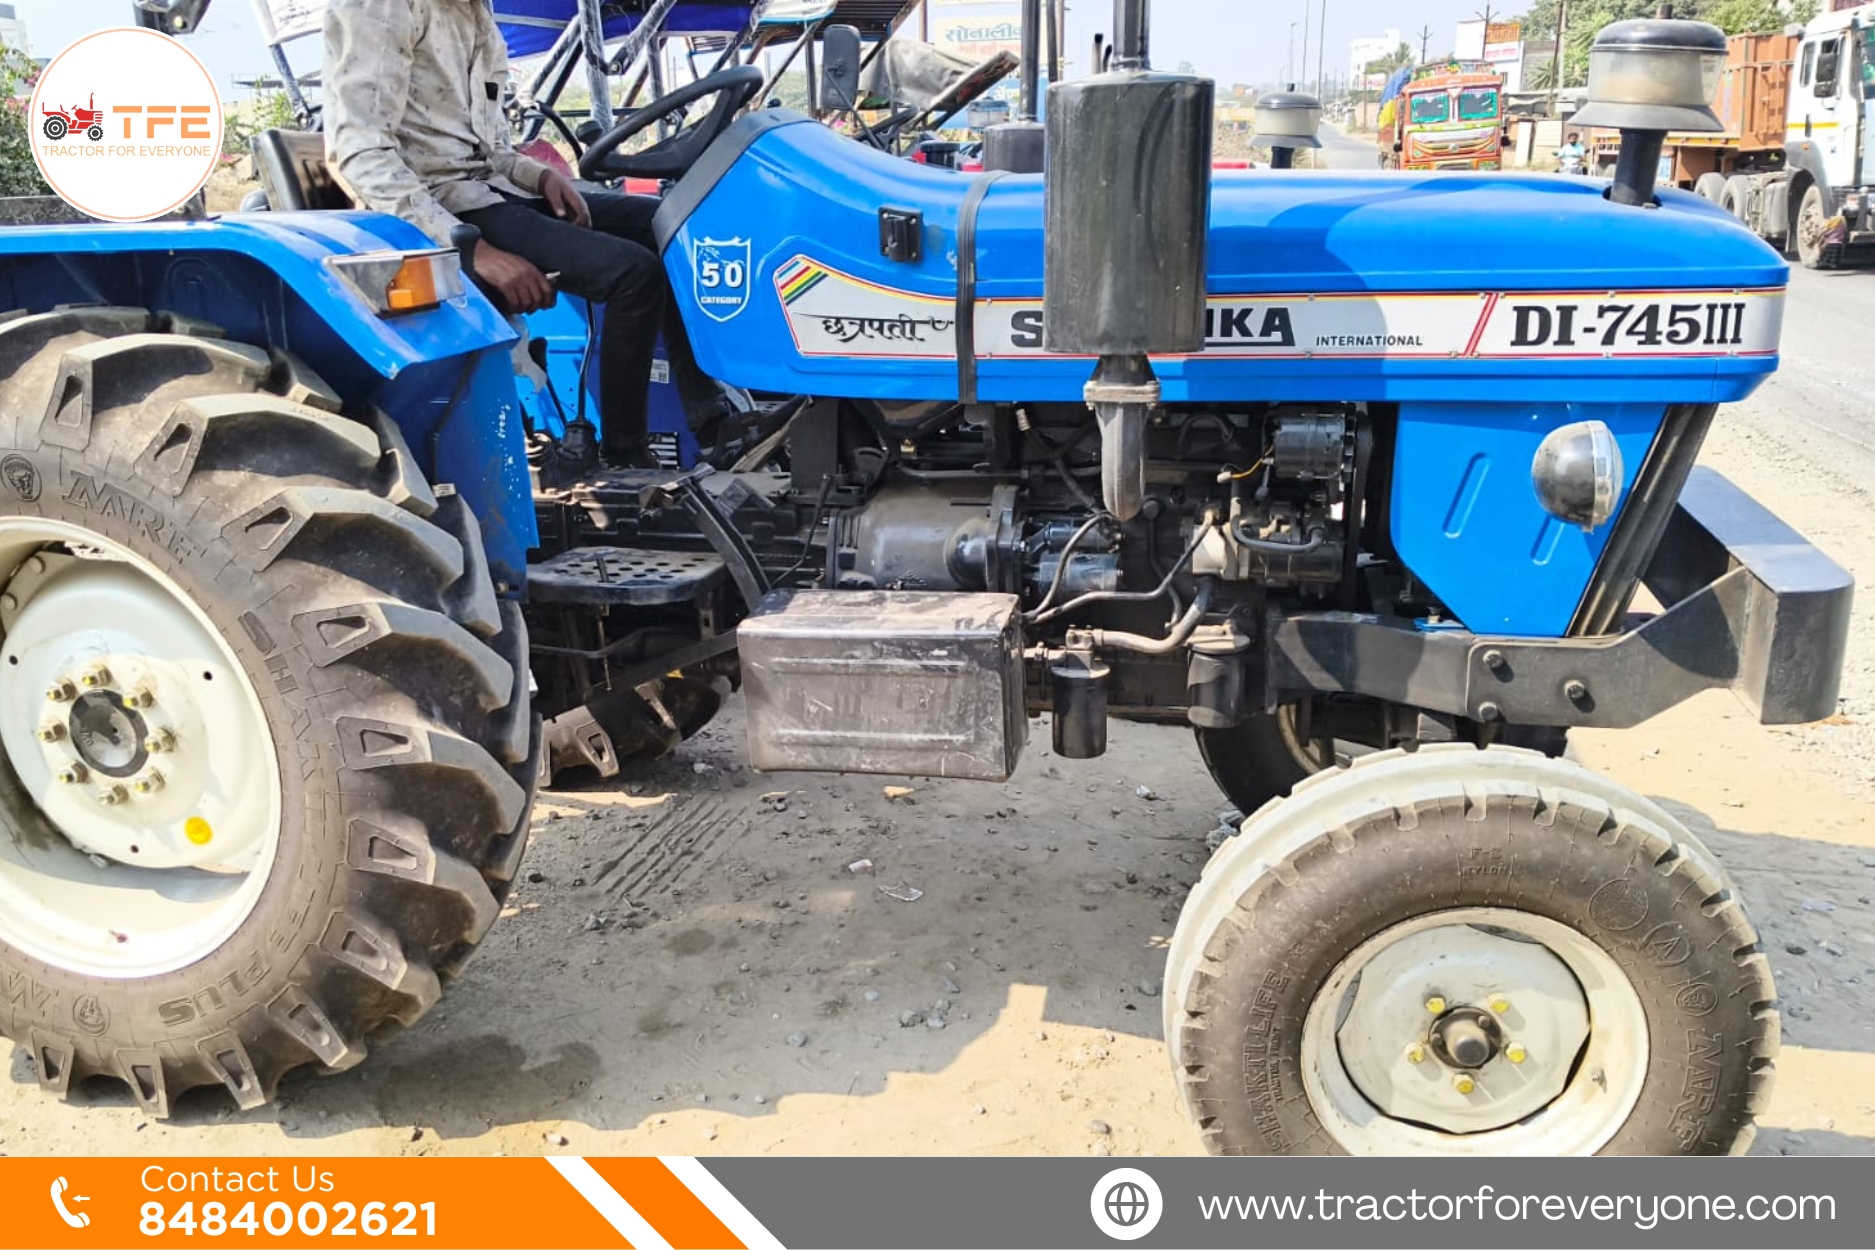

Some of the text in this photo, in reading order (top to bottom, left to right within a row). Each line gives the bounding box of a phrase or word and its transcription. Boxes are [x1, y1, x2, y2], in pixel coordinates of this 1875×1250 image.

[701, 261, 743, 288] 50
[700, 296, 742, 305] CATEGORY
[800, 313, 953, 342] छत्रपती
[1315, 334, 1424, 347] INTERNATIONAL
[1510, 303, 1746, 347] DI-745III
[61, 469, 208, 565] MRF
[157, 950, 273, 1028] PLUS
[1249, 970, 1290, 1037] LIFE
[1667, 1029, 1723, 1151] MRF
